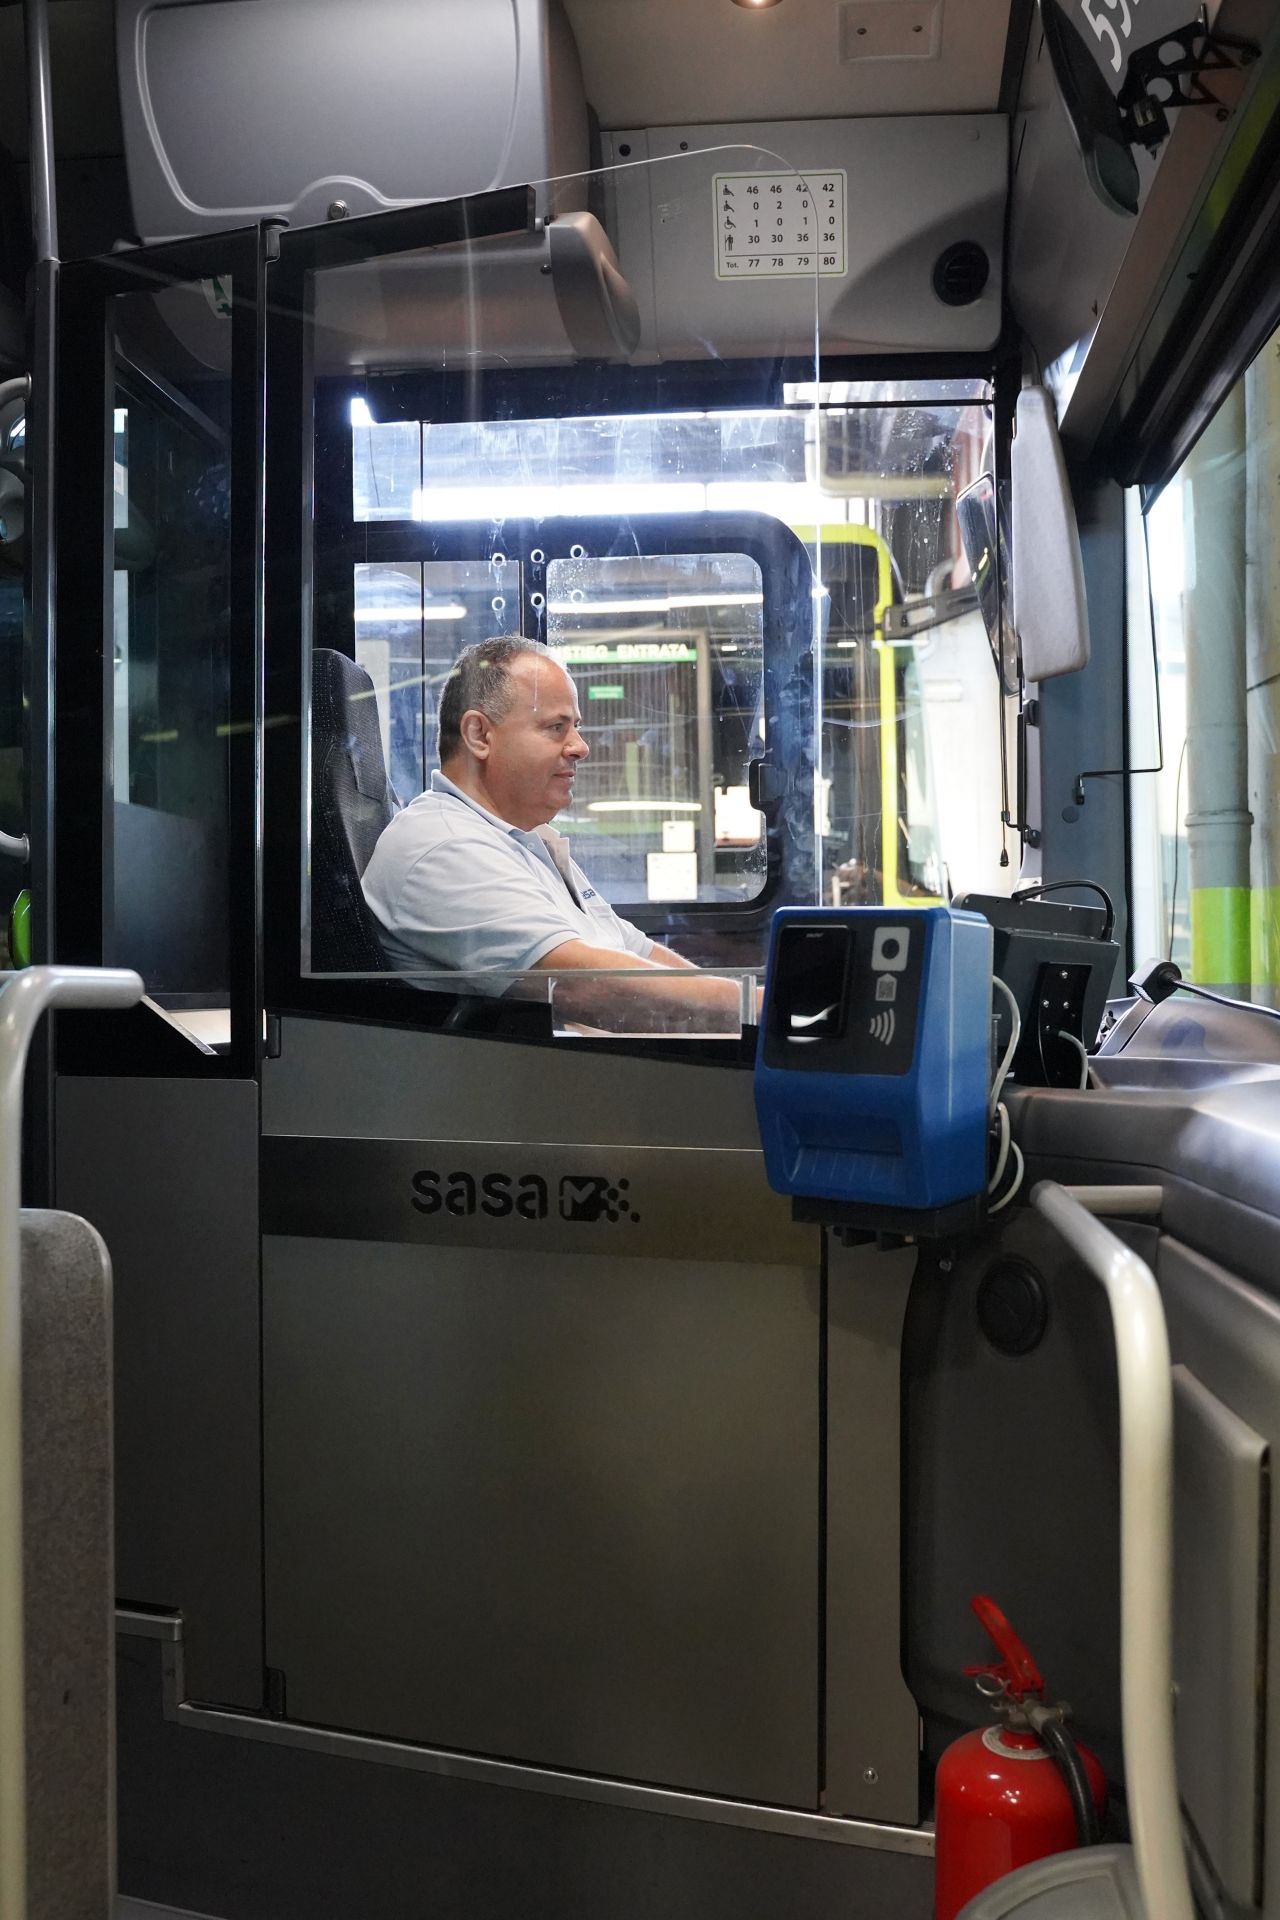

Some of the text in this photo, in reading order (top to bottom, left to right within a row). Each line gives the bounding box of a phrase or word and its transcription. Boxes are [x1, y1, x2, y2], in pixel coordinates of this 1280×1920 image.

[746, 183, 835, 195] 46 46 42 42
[753, 199, 835, 211] 0 2 0 2
[754, 216, 835, 228] 1 0 1 0
[747, 232, 836, 244] 30 30 36 36
[726, 256, 836, 269] Tot. 77 78 79 80
[617, 644, 689, 659] ENTRATA
[411, 1170, 548, 1219] sasa
